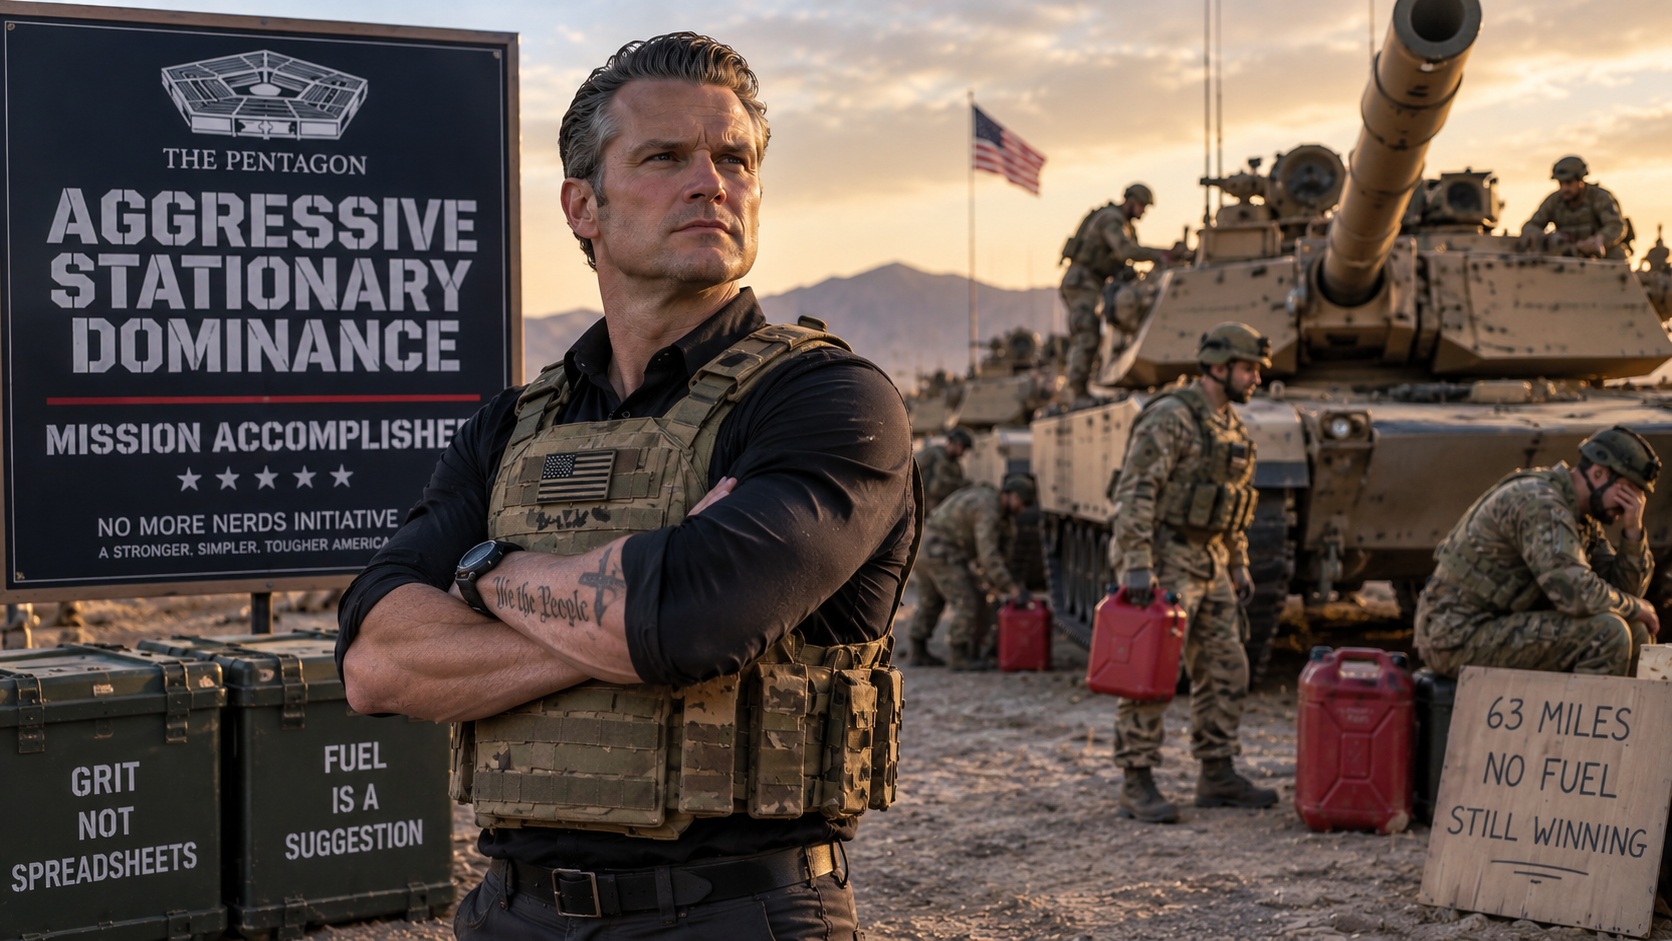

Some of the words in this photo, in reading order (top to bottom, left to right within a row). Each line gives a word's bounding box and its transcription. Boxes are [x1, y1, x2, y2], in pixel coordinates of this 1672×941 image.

[163, 148, 217, 170] THE
[226, 151, 367, 175] PENTAGON
[47, 188, 477, 252] AGGRESSIVE
[51, 252, 472, 311] STATIONARY
[73, 317, 460, 373] DOMINANCE
[46, 422, 201, 455] MISSION
[98, 517, 131, 537] NO
[140, 515, 206, 535] MORE
[213, 512, 287, 533] NERDS
[294, 509, 398, 530] INITIATIVE
[98, 546, 109, 559] A
[265, 538, 329, 553] TOUGHER
[493, 576, 515, 609] We
[516, 582, 536, 617] the
[538, 585, 589, 627] People
[1487, 696, 1524, 731] 63
[1538, 701, 1632, 741] MILES
[324, 741, 387, 774] FUEL
[1483, 751, 1525, 787] NO
[1540, 758, 1617, 798] FUEL
[72, 761, 140, 797] GRIT
[332, 785, 355, 814] IS
[362, 783, 379, 811] A
[79, 806, 135, 841] NOT
[285, 819, 424, 861] SUGGESTION
[1448, 806, 1518, 842] STILL
[1533, 816, 1647, 858] WINNING
[11, 841, 198, 893] SPREADSHEETS
